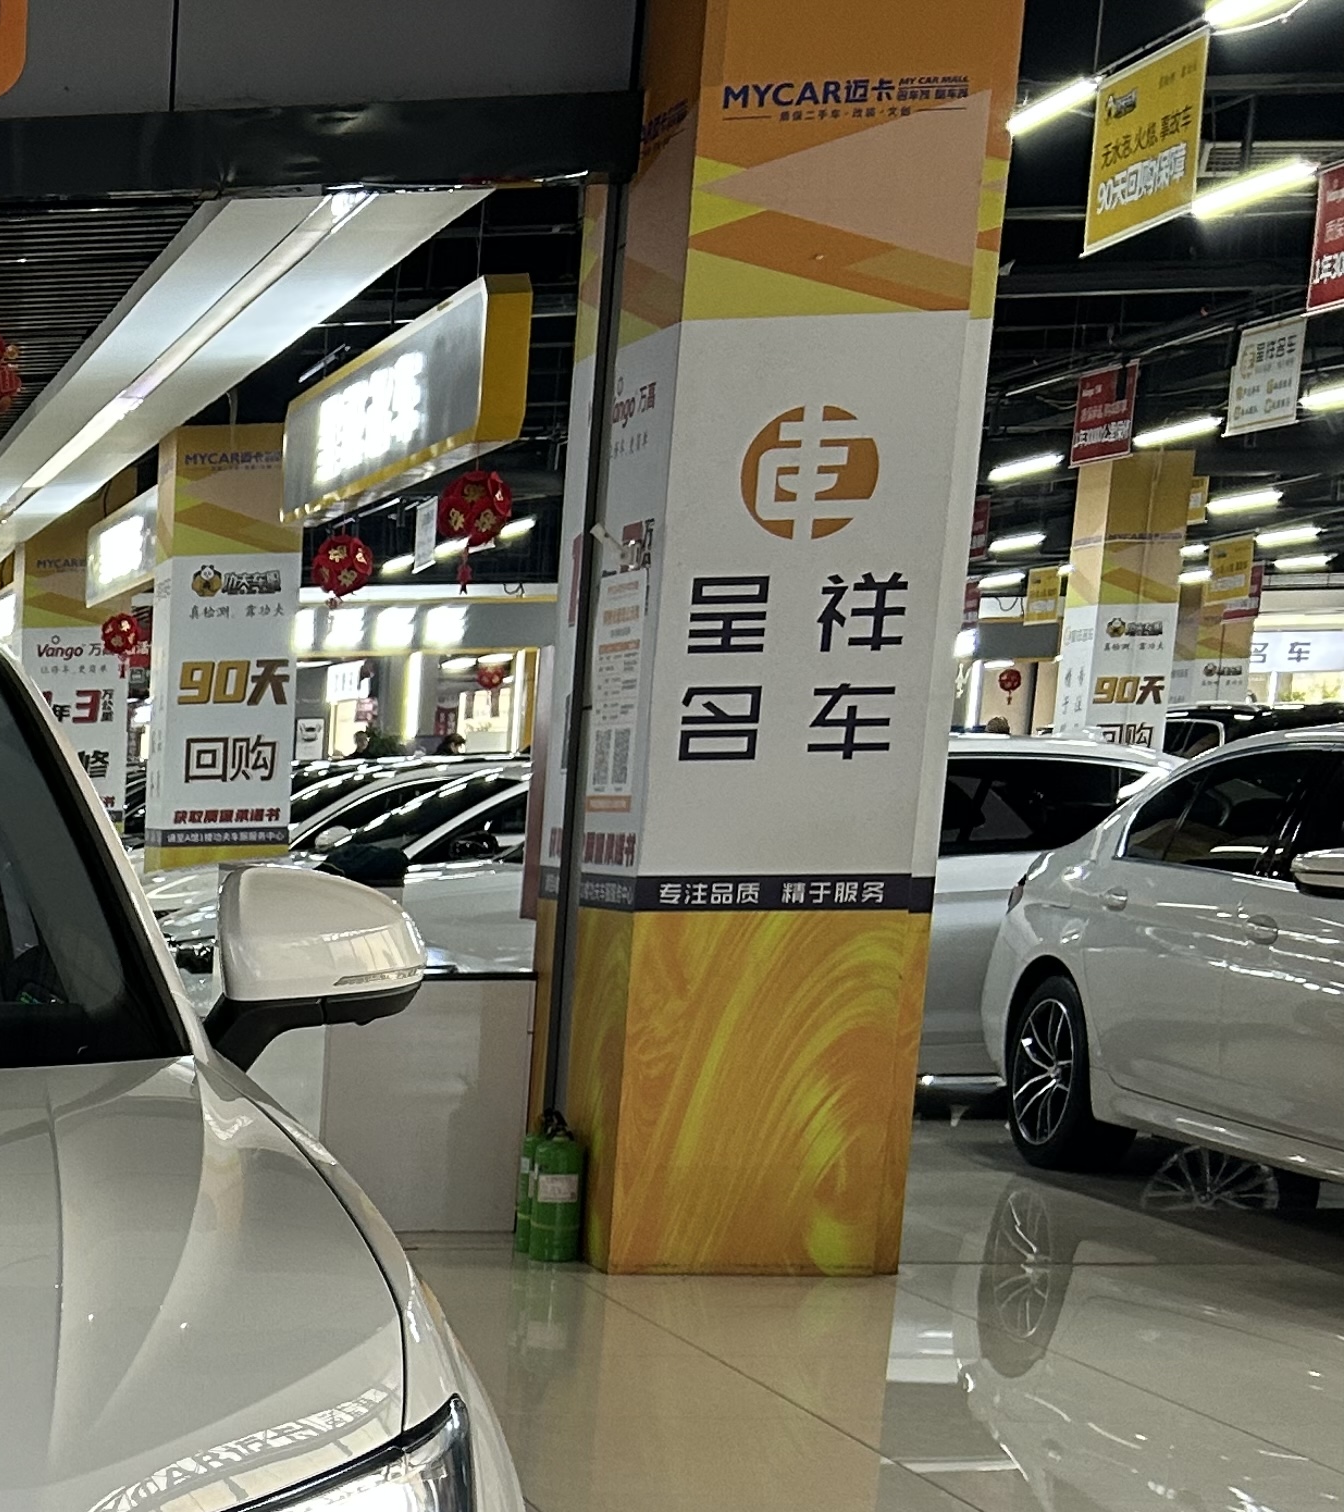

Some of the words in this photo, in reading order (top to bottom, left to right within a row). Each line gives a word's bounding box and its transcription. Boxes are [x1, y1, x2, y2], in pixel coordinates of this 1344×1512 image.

[688, 571, 910, 654] 呈祥
[37, 644, 84, 661] Vango
[177, 658, 291, 706] 90天
[1093, 675, 1165, 705] 90天
[678, 683, 897, 763] 名车
[184, 734, 279, 784] 回购
[659, 881, 760, 905] 专注品质
[781, 881, 886, 904] 精于服务
